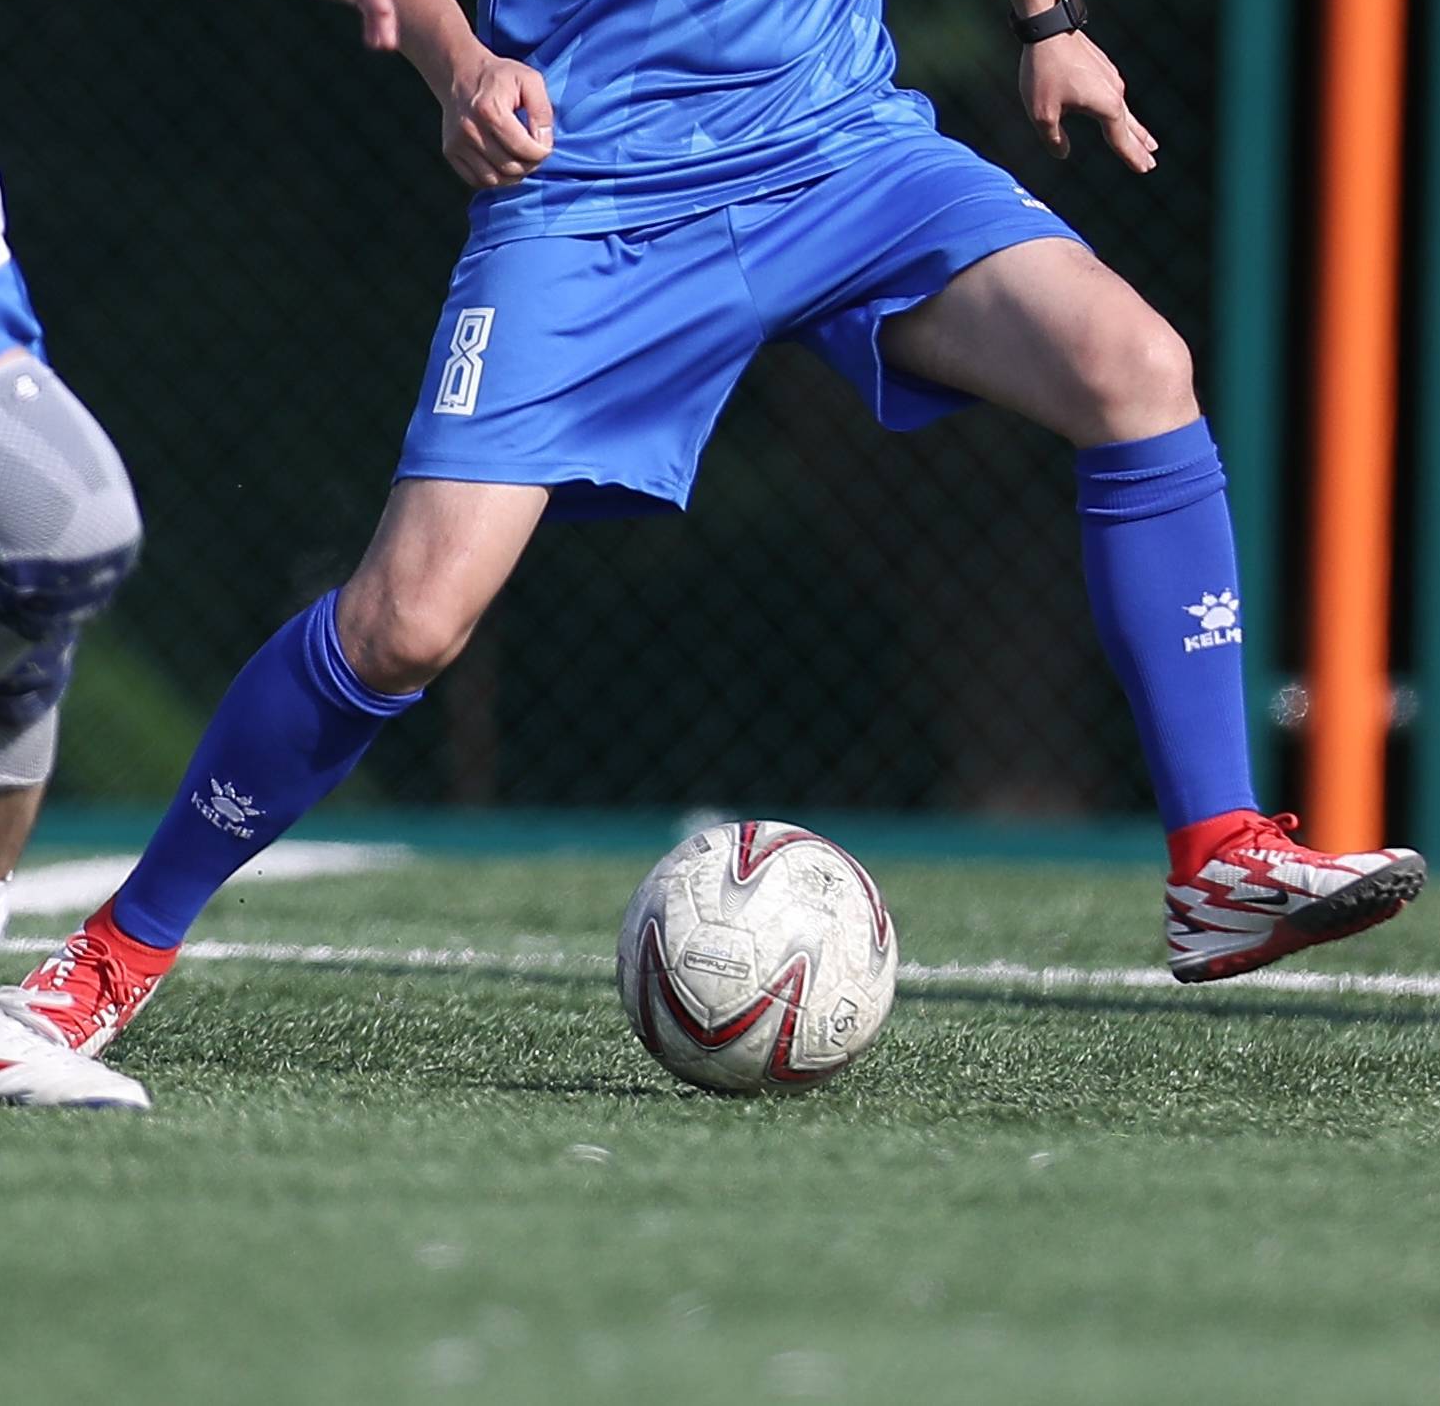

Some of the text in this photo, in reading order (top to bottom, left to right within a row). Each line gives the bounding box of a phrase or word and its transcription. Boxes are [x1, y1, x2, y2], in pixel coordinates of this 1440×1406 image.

[432, 306, 496, 416] 8
[1182, 627, 1243, 652] KELM
[190, 790, 255, 840] KELME
[834, 1016, 855, 1034] 5
